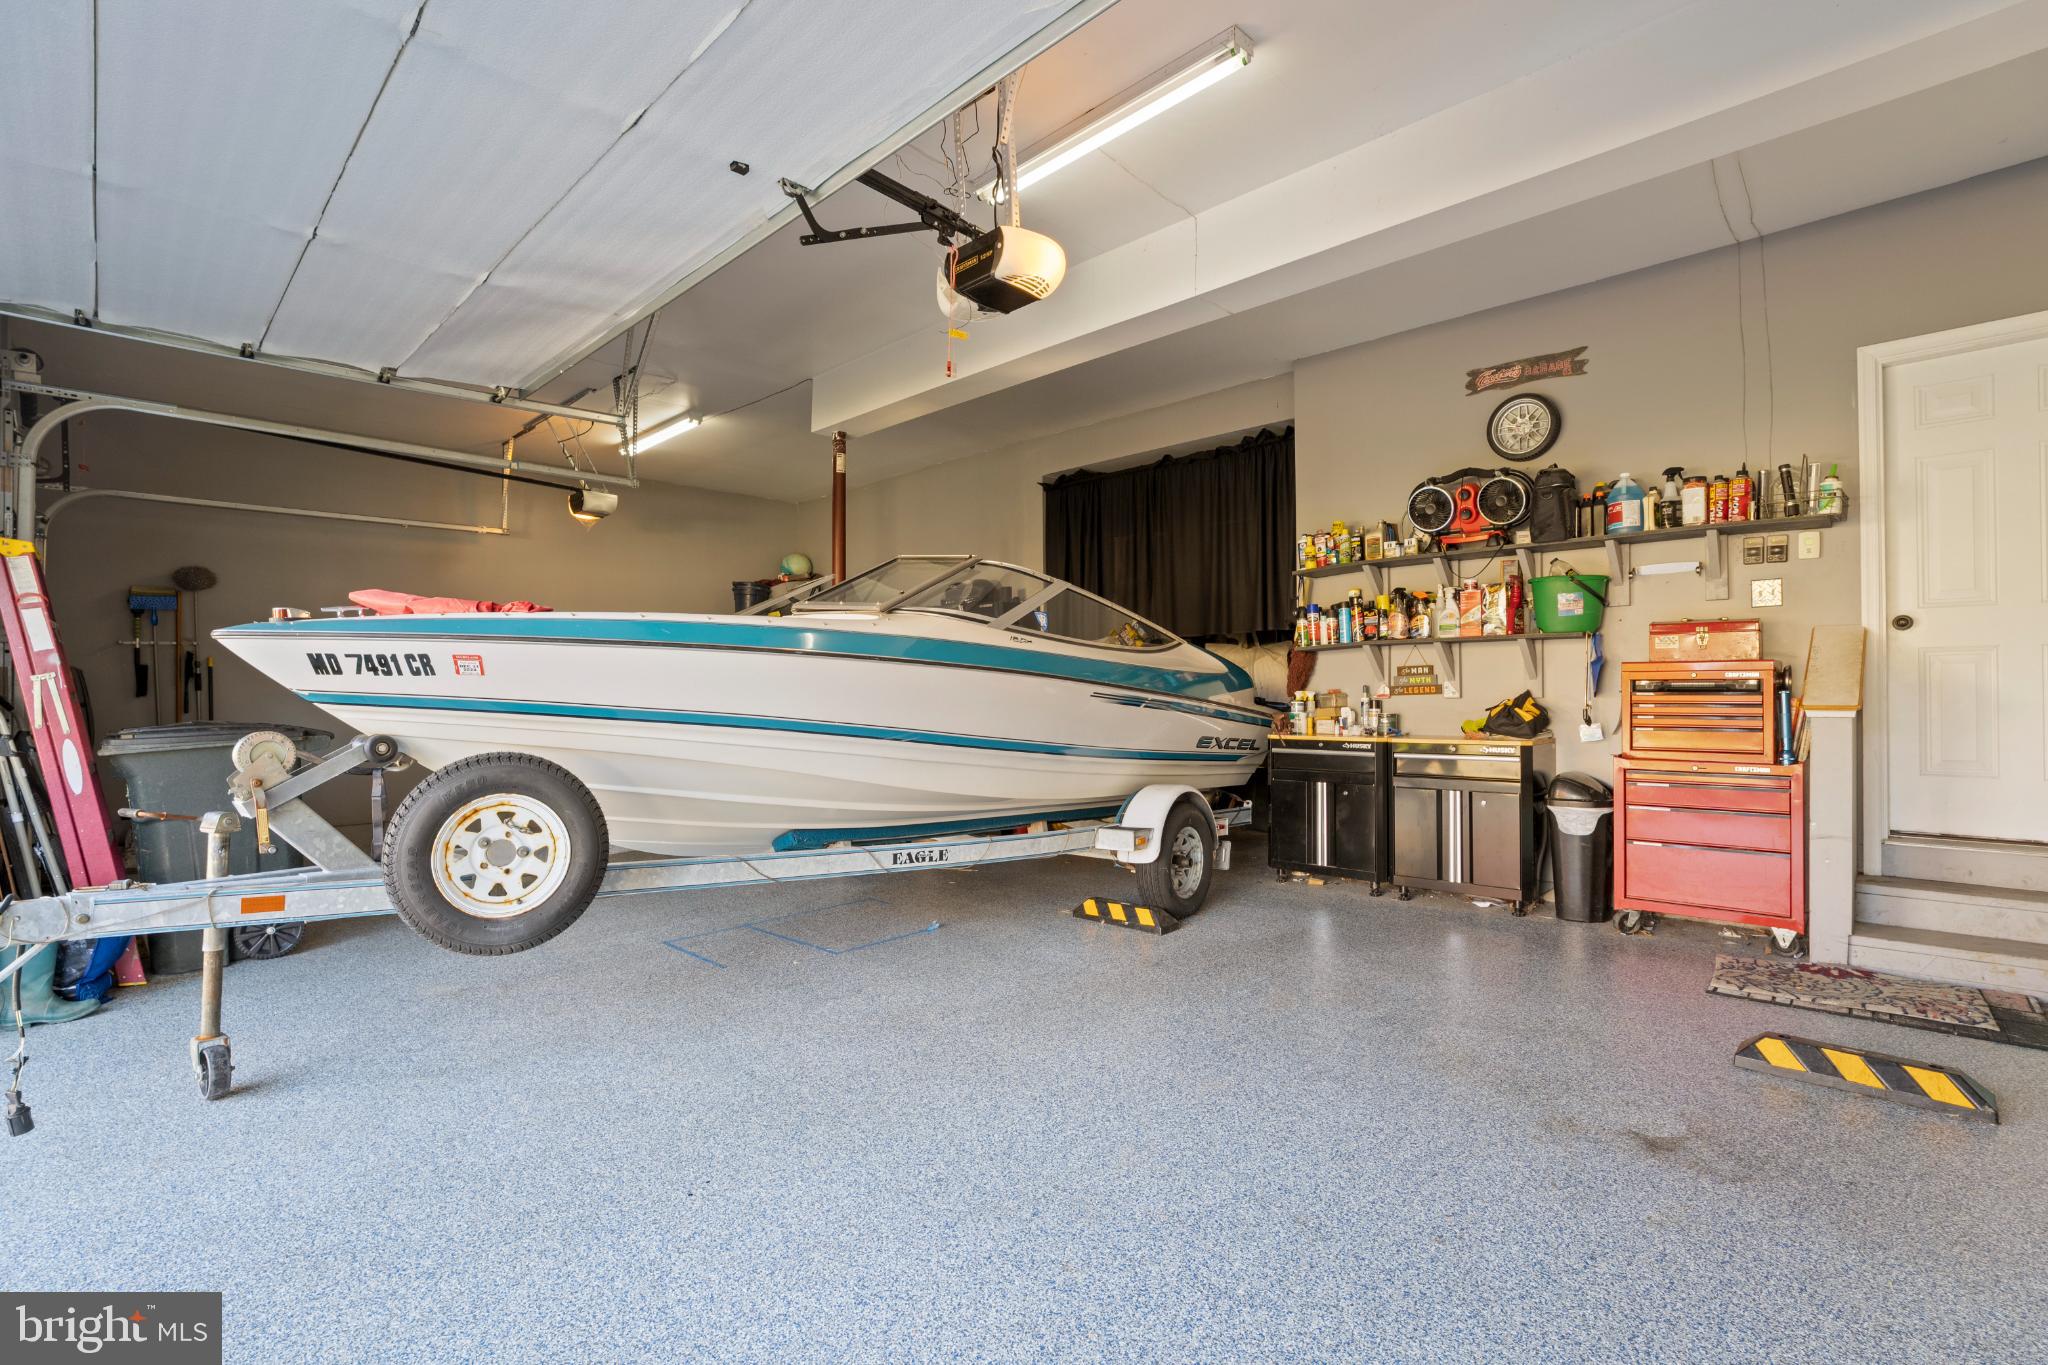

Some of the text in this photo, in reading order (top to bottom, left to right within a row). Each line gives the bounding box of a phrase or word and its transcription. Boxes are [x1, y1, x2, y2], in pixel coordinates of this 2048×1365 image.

[306, 653, 436, 676] MD 7491 CR
[1404, 686, 1436, 694] LEGEND
[1196, 736, 1260, 750] EXCEL
[1489, 746, 1516, 754] HUSKY
[892, 849, 949, 865] EAGLE
